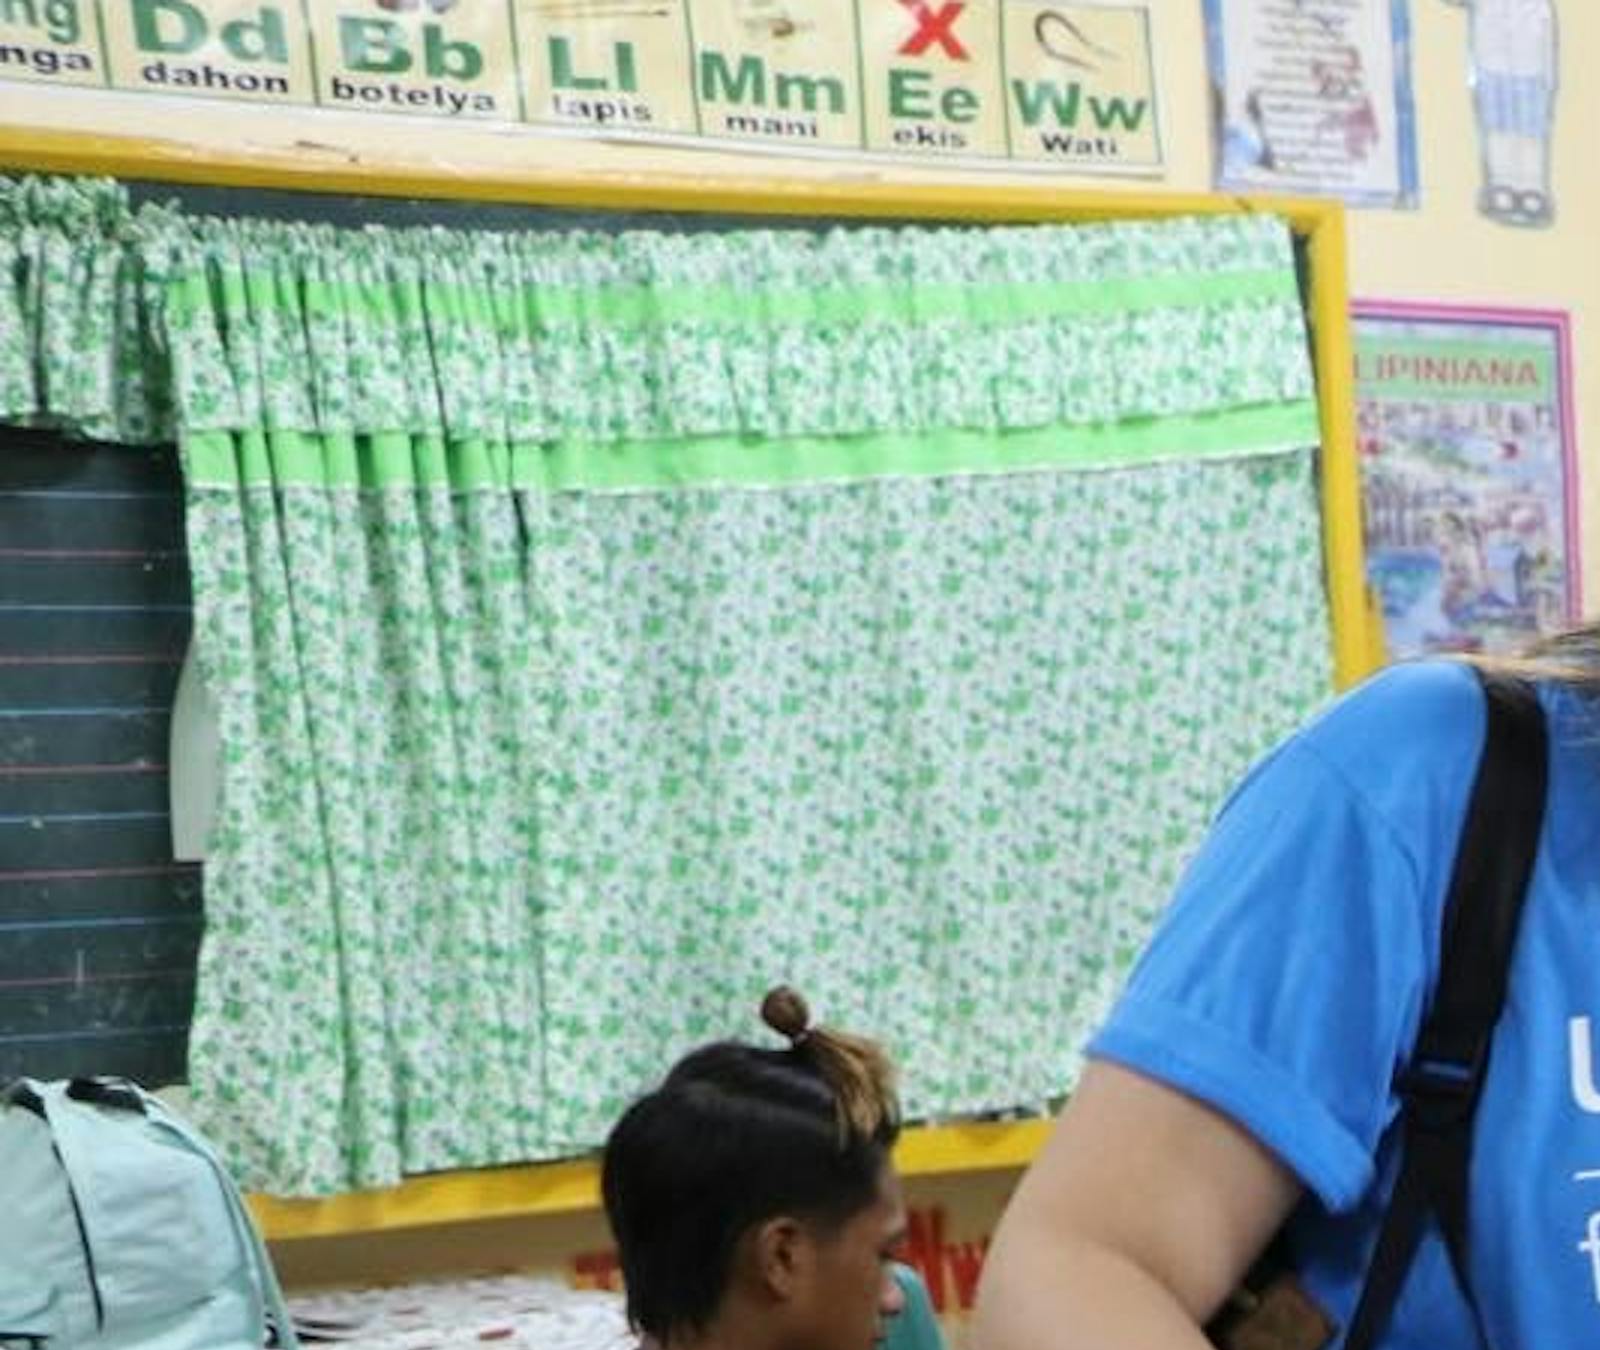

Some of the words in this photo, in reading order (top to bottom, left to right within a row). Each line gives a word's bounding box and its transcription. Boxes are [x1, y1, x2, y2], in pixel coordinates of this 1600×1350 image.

[131, 0, 288, 64] Dd
[337, 15, 483, 81] Bb
[143, 63, 288, 94] dahon
[548, 37, 638, 92] Ll
[701, 51, 846, 115] Mm
[332, 77, 496, 115] botelya
[552, 93, 653, 123] lapis
[888, 69, 980, 124] Ee
[1012, 78, 1147, 131] Ww
[727, 114, 819, 138] mani
[894, 125, 967, 150] ekis
[1041, 132, 1117, 155] Wati
